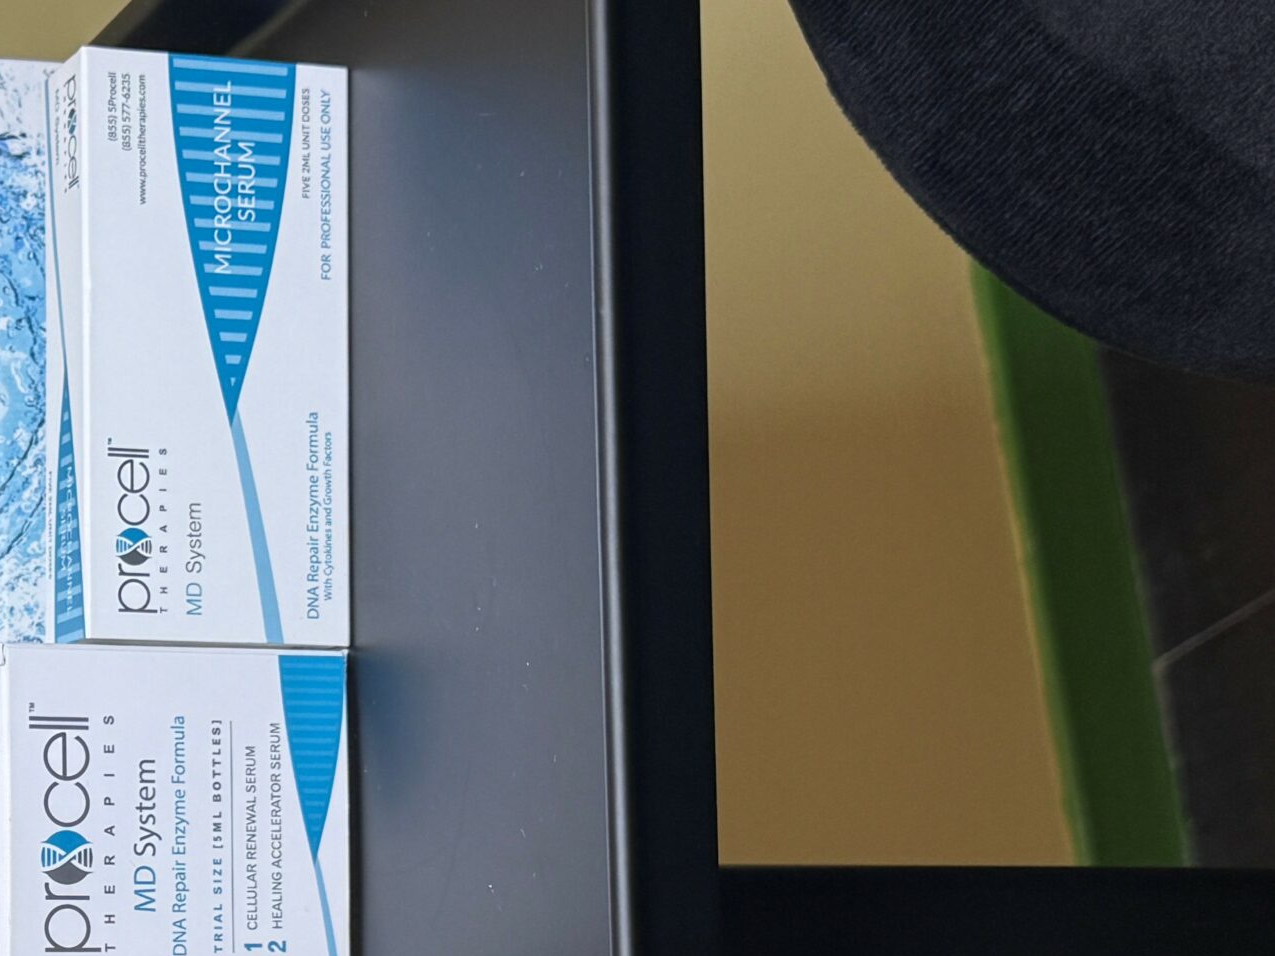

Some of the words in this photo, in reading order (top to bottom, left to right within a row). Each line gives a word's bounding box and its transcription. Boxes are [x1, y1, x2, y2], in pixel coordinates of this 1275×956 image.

[107, 72, 117, 113] 5Procell
[121, 73, 131, 123] 577-6235
[301, 88, 310, 123] DOSES
[321, 89, 331, 124] ONLY
[107, 115, 118, 142] (855)
[121, 124, 132, 151] (855)
[137, 74, 147, 204] www.procelltherapies.com
[301, 125, 310, 150] UNIT
[321, 126, 331, 151] USE
[213, 80, 232, 274] MICROCHANNEL
[238, 141, 255, 222] SERUM
[301, 152, 310, 174] 2ML
[301, 176, 310, 199] FIVE
[321, 153, 331, 249] PROFESSIONAL
[321, 254, 331, 280] FOR
[306, 412, 318, 471] Formula
[323, 432, 332, 466] Factors
[306, 475, 320, 533] Enzyme
[323, 469, 333, 506] Growth
[107, 447, 157, 613] procell
[159, 448, 167, 613] THERAPIES
[186, 503, 205, 574] System
[323, 507, 332, 526] and
[307, 537, 320, 582] Repair
[323, 529, 333, 576] Cytokines
[186, 582, 202, 615] MD
[307, 587, 319, 619] DNA
[323, 578, 332, 601] With
[171, 716, 186, 784] Formula
[211, 719, 222, 802] BOTTLES]
[245, 746, 257, 793] SERUM
[270, 722, 281, 770] SERUM
[133, 759, 161, 857] System
[172, 789, 188, 855] Enzyme
[212, 811, 223, 849] [5ML
[246, 797, 257, 860] RENEWAL
[271, 773, 282, 869] ACCELERATOR
[29, 716, 101, 953] procell
[103, 715, 116, 952] THERAPIES
[133, 866, 157, 912] MD
[172, 860, 189, 913] Repair
[213, 857, 222, 894] SIZE
[246, 864, 258, 930] CELLULAR
[272, 872, 283, 929] HEALING
[173, 919, 187, 956] DNA
[213, 903, 223, 953] TRIAL
[244, 942, 263, 951] 1
[267, 940, 286, 953] 2
